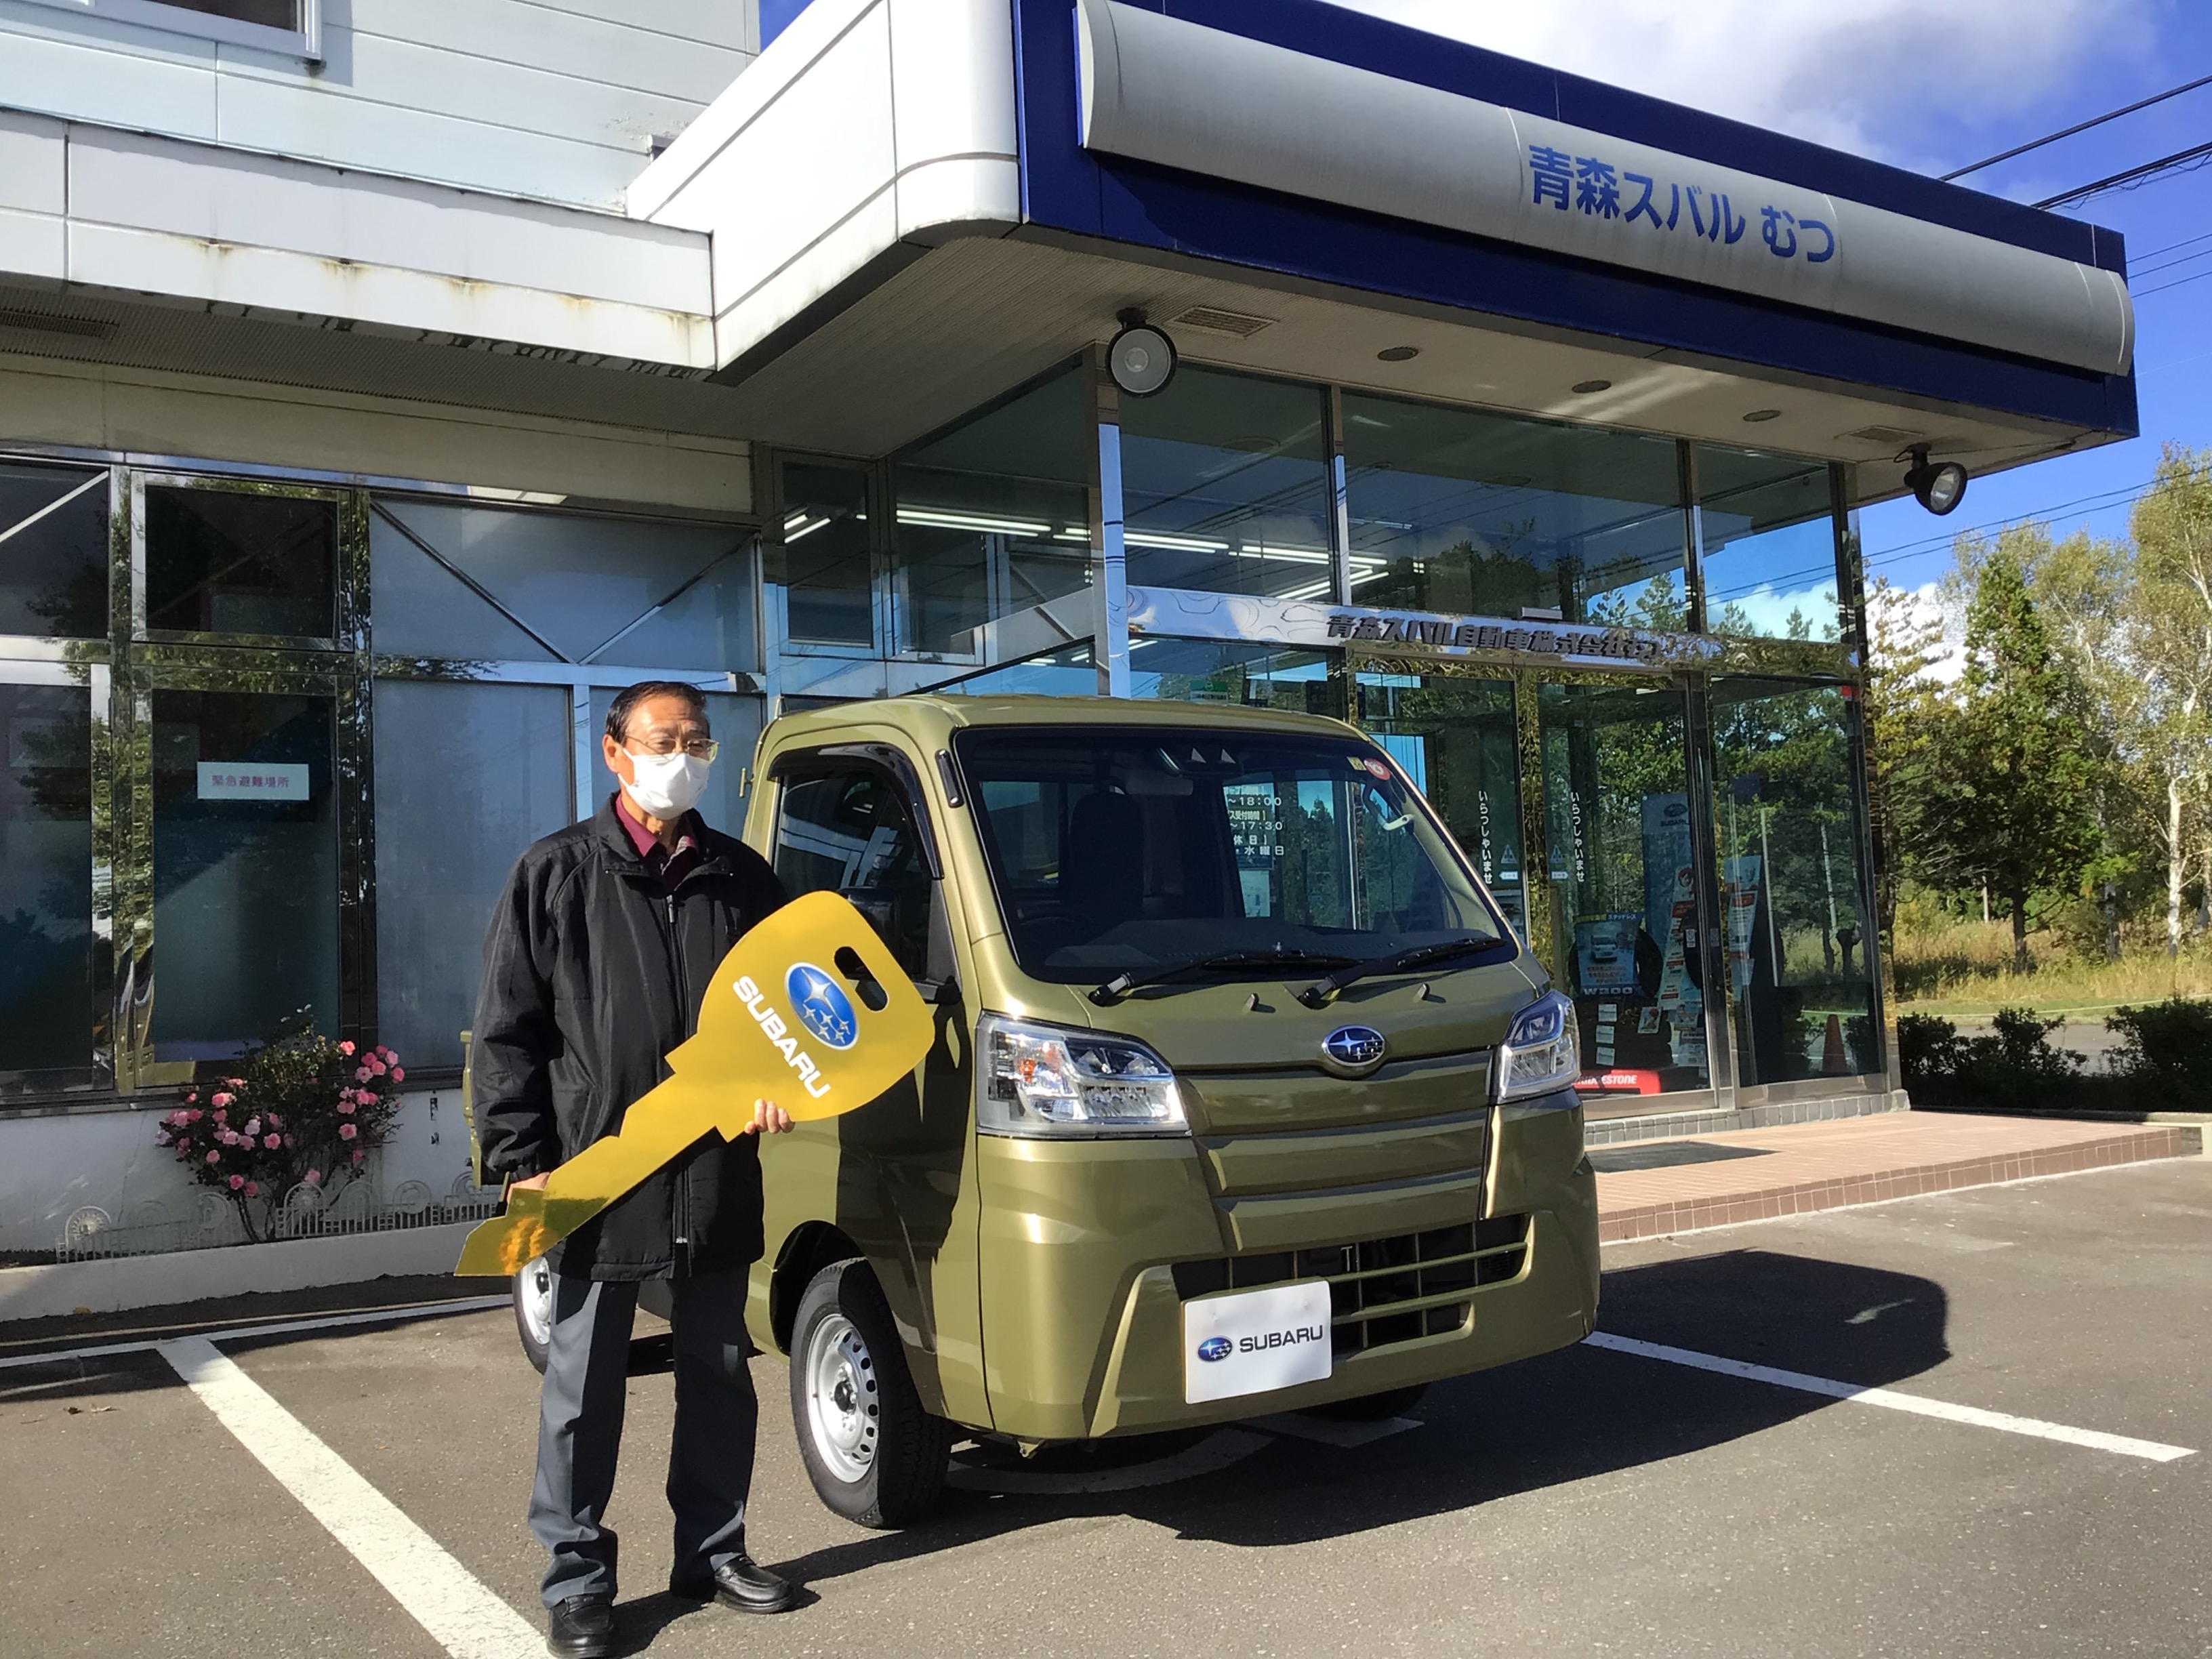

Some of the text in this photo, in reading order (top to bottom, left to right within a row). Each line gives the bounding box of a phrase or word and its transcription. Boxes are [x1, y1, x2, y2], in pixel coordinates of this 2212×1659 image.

[1529, 144, 1835, 263] 青森スバル むつ
[212, 775, 289, 788] 緊急避難場所
[1478, 790, 1493, 884] いらっしゃいませ
[1570, 792, 1585, 882] いらっしゃいませ
[733, 976, 831, 1099] SUBARU
[1240, 1325, 1323, 1353] SUBARU
